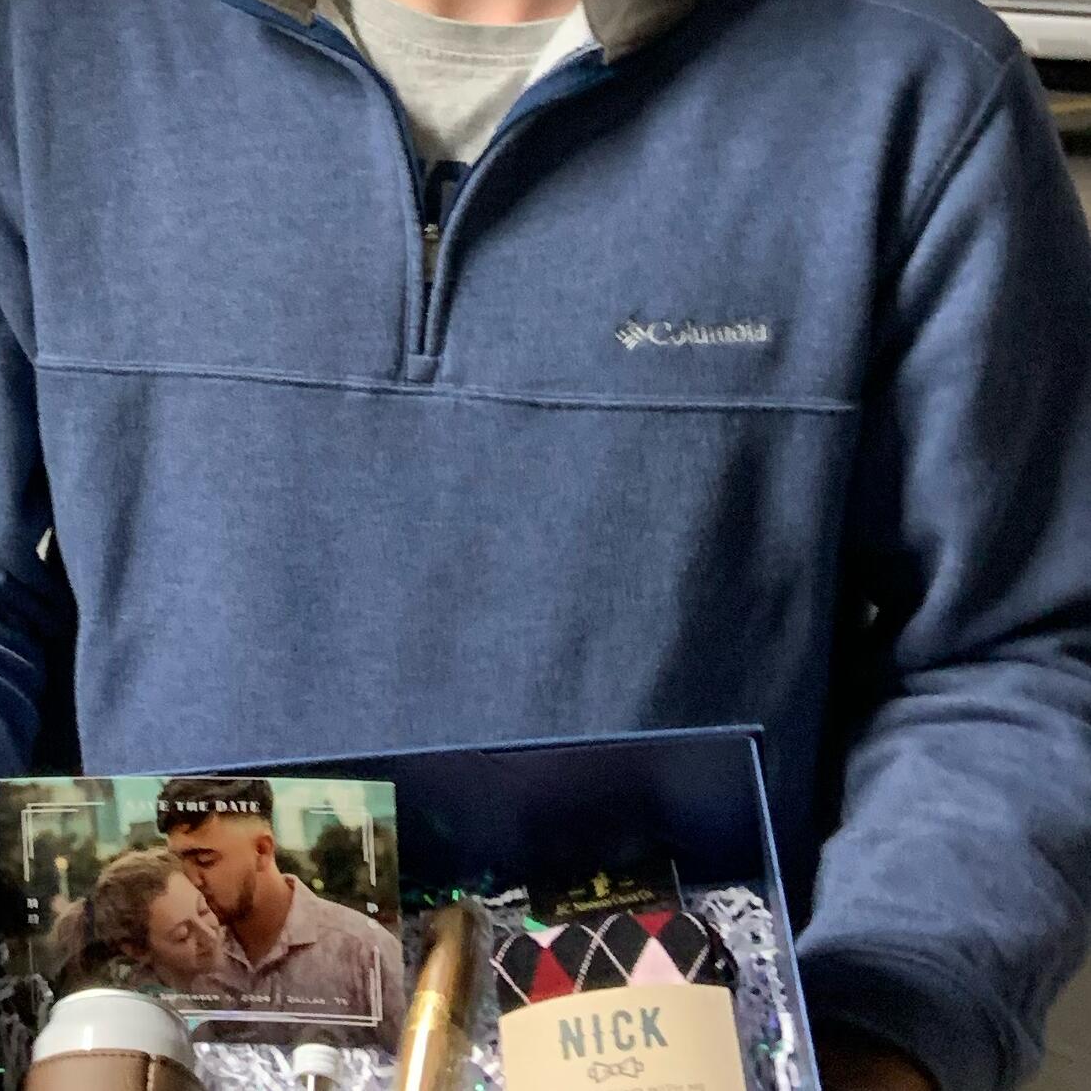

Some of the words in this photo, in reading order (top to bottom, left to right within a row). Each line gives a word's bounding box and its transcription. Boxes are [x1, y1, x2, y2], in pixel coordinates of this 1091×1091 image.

[175, 800, 209, 813] THE
[215, 800, 260, 813] DATE
[559, 1006, 668, 1060] NICK
